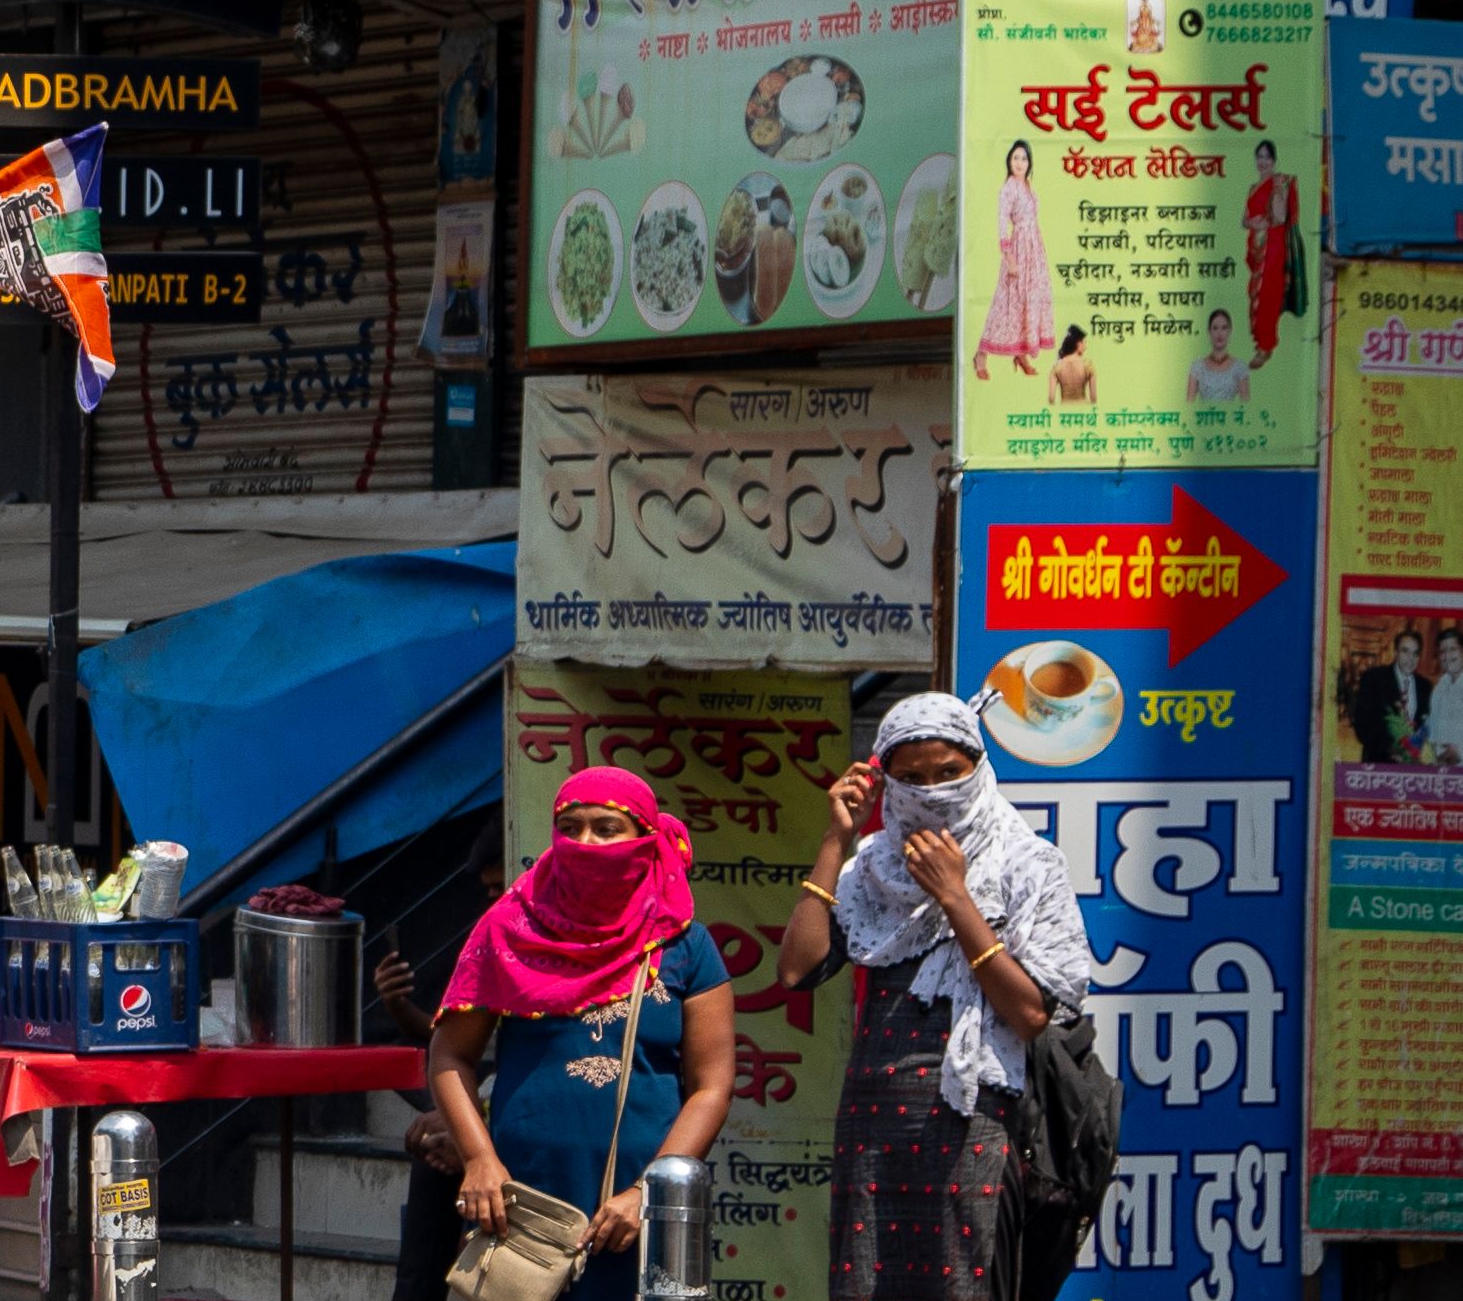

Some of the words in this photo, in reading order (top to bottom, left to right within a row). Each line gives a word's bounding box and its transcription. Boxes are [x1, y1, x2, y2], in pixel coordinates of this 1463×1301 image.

[715, 16, 793, 52] भोजनालय
[818, 1, 862, 40] लस्सी
[1206, 26, 1313, 44] 7666823217
[1020, 63, 1111, 141] सई
[1126, 62, 1270, 132] टेलर्स
[1062, 146, 1136, 180] फॅशन
[1145, 145, 1226, 179] लेडिज
[1078, 228, 1137, 254] पंजाबी,
[1146, 227, 1216, 250] पटियाला
[1197, 256, 1237, 279] साडी
[203, 273, 248, 304] B-2
[1087, 287, 1150, 311] वनपीस,
[1364, 318, 1410, 363] श्री
[729, 380, 791, 422] सारंग
[1007, 408, 1052, 428] स्वामी
[1059, 407, 1098, 427] समर्थ
[1195, 406, 1226, 427] शॉप
[1073, 433, 1108, 455] मंदिर
[1115, 433, 1161, 456] समोर,
[1168, 432, 1195, 458] पुणे
[1001, 534, 1034, 600] श्री
[1037, 534, 1124, 600] गोवर्धन
[1127, 534, 1155, 600] टी
[1158, 534, 1243, 600] कॅन्टीन
[524, 589, 601, 632] धार्मिक
[608, 590, 710, 633] अध्यात्मिक
[717, 590, 793, 633] ज्योतिष
[798, 590, 914, 648] आयुर्वेदीक
[1139, 689, 1236, 743] उत्कृष्ट
[677, 784, 782, 834] डेपो
[1370, 894, 1436, 921] Stone
[117, 1015, 157, 1032] pepsi
[120, 1186, 149, 1203] BASIS
